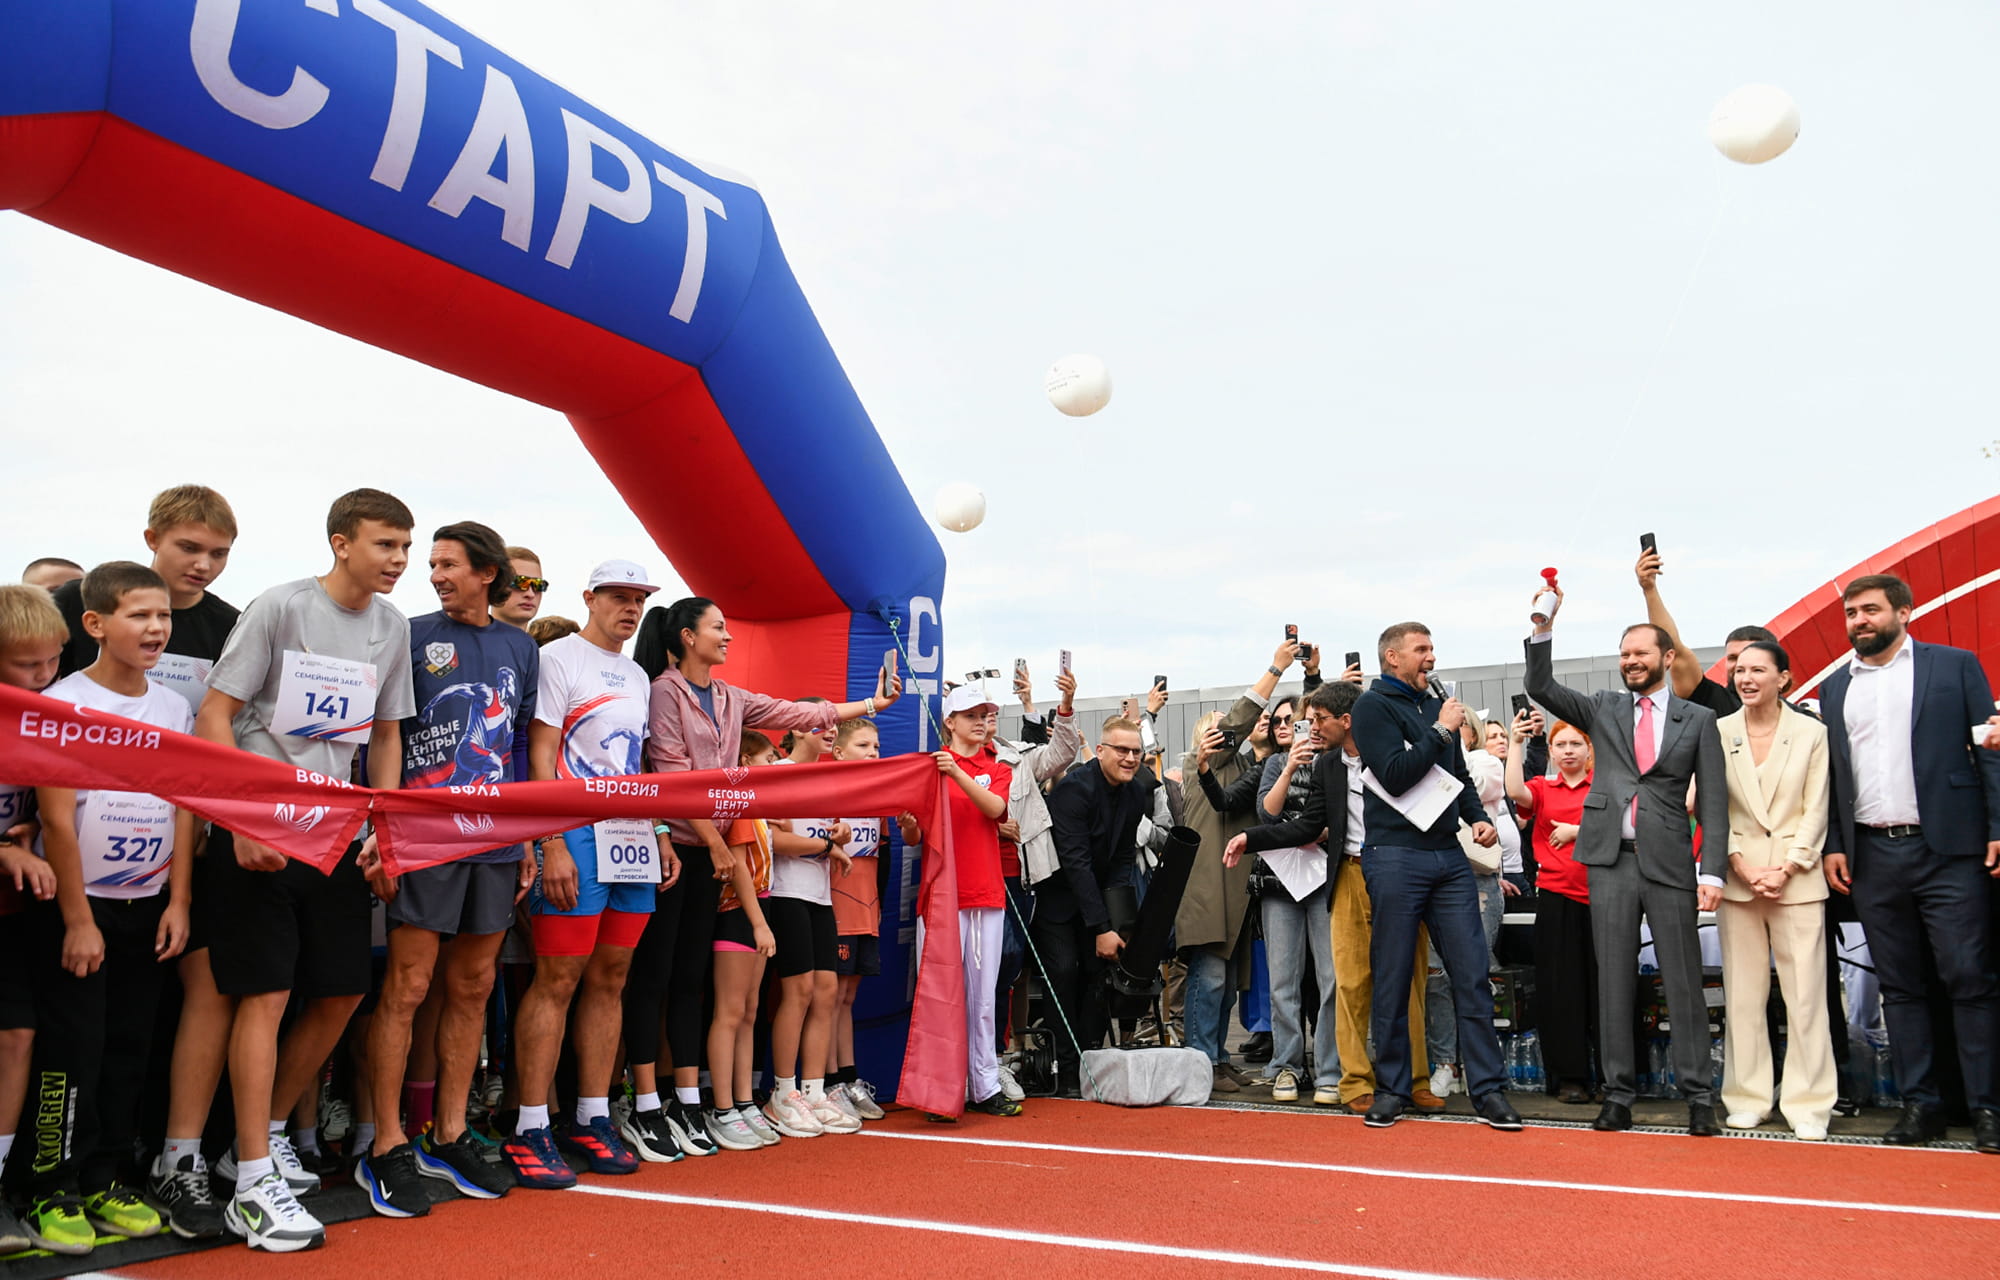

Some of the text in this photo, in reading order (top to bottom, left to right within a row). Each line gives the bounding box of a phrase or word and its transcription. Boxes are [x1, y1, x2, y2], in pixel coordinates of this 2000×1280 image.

[190, 0, 728, 324] СТАРТ
[294, 671, 363, 687] СЕМЕЙНЫЙ ЗАБЕГ
[305, 691, 349, 720] 141
[19, 710, 161, 750] Евразия
[408, 719, 460, 745] ЕГОВЫЕ
[296, 768, 354, 790] ВФЛА
[584, 777, 659, 798] Евразия
[450, 785, 501, 797] ВФЛА
[708, 788, 756, 800] БЕГОВОЙ
[715, 799, 750, 811] ЦЕНТР
[100, 814, 152, 825] СЕМЕЙНЫЙ
[806, 827, 832, 838] 29
[852, 827, 877, 843] 278
[102, 835, 163, 862] 327
[610, 844, 650, 864] 008
